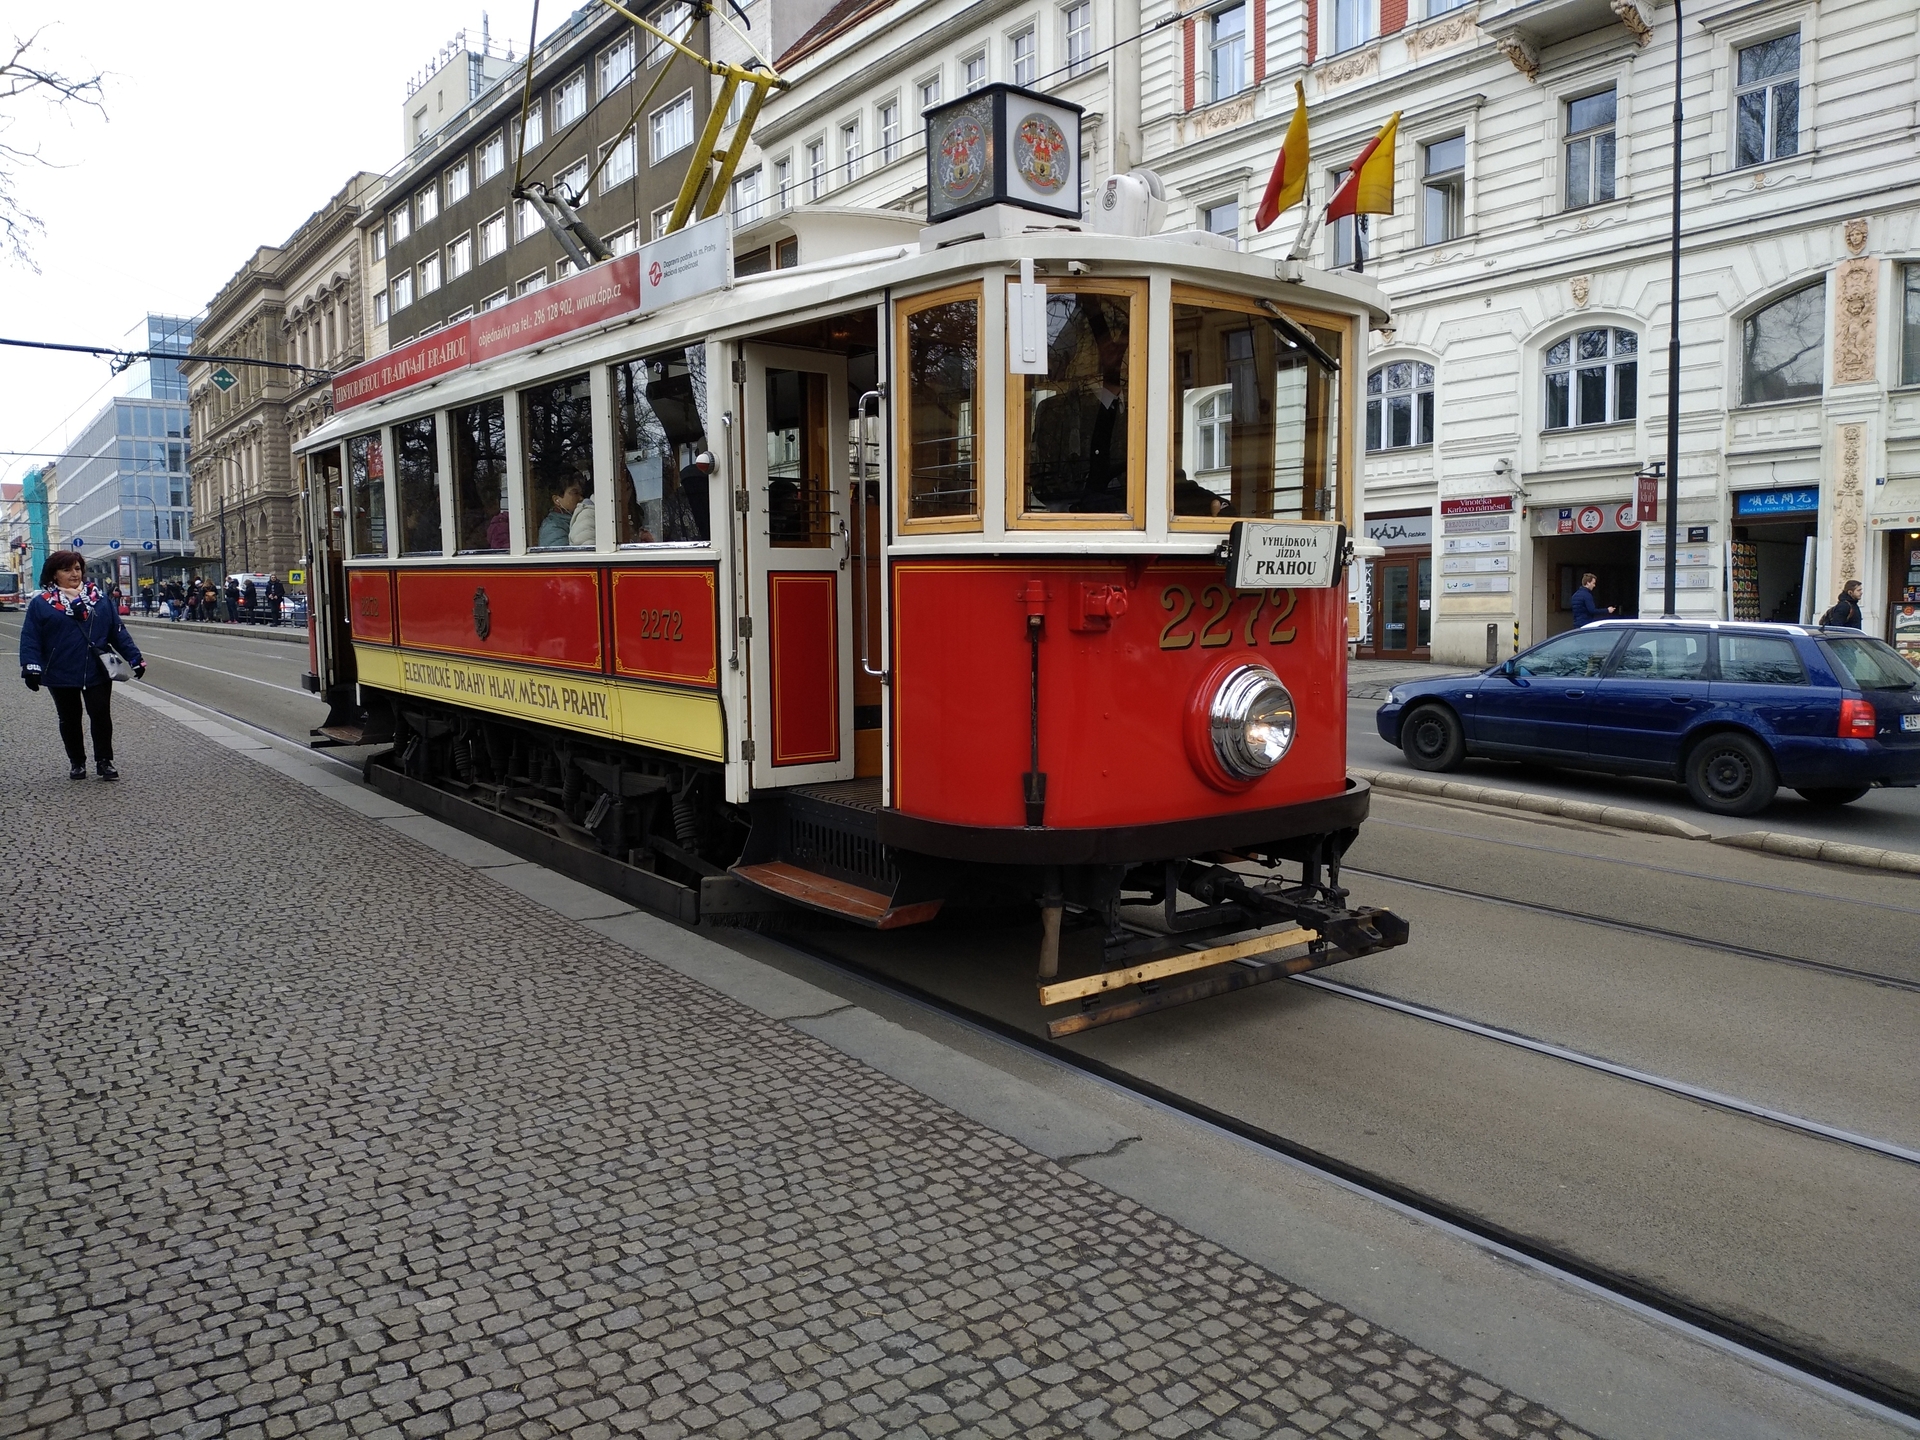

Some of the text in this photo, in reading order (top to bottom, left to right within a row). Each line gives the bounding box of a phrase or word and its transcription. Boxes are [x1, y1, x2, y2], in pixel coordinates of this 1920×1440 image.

[680, 252, 692, 264] podnik
[678, 260, 699, 274] společnost
[478, 284, 621, 346] objednávky na tel.: 296 128 902, www.dpp.cz
[382, 349, 425, 385] TRAMVAJÍ
[428, 336, 466, 368] PRAHOU
[1639, 480, 1657, 493] Vinný
[1640, 492, 1655, 502] klub
[1448, 503, 1505, 514] Karlovo náměstí
[1370, 523, 1407, 540] KÁJA
[1262, 535, 1318, 547] VYHLÍDKOVÁ
[1275, 546, 1301, 559] JÍZDA
[1256, 560, 1317, 576] PRAHOU
[361, 596, 380, 618] 2272
[1159, 584, 1297, 649] 2272
[640, 609, 683, 641] 2272
[404, 662, 608, 720] ELEKTRICKÉ DRÁHY HLAV. MĚSTA PRAHY.
